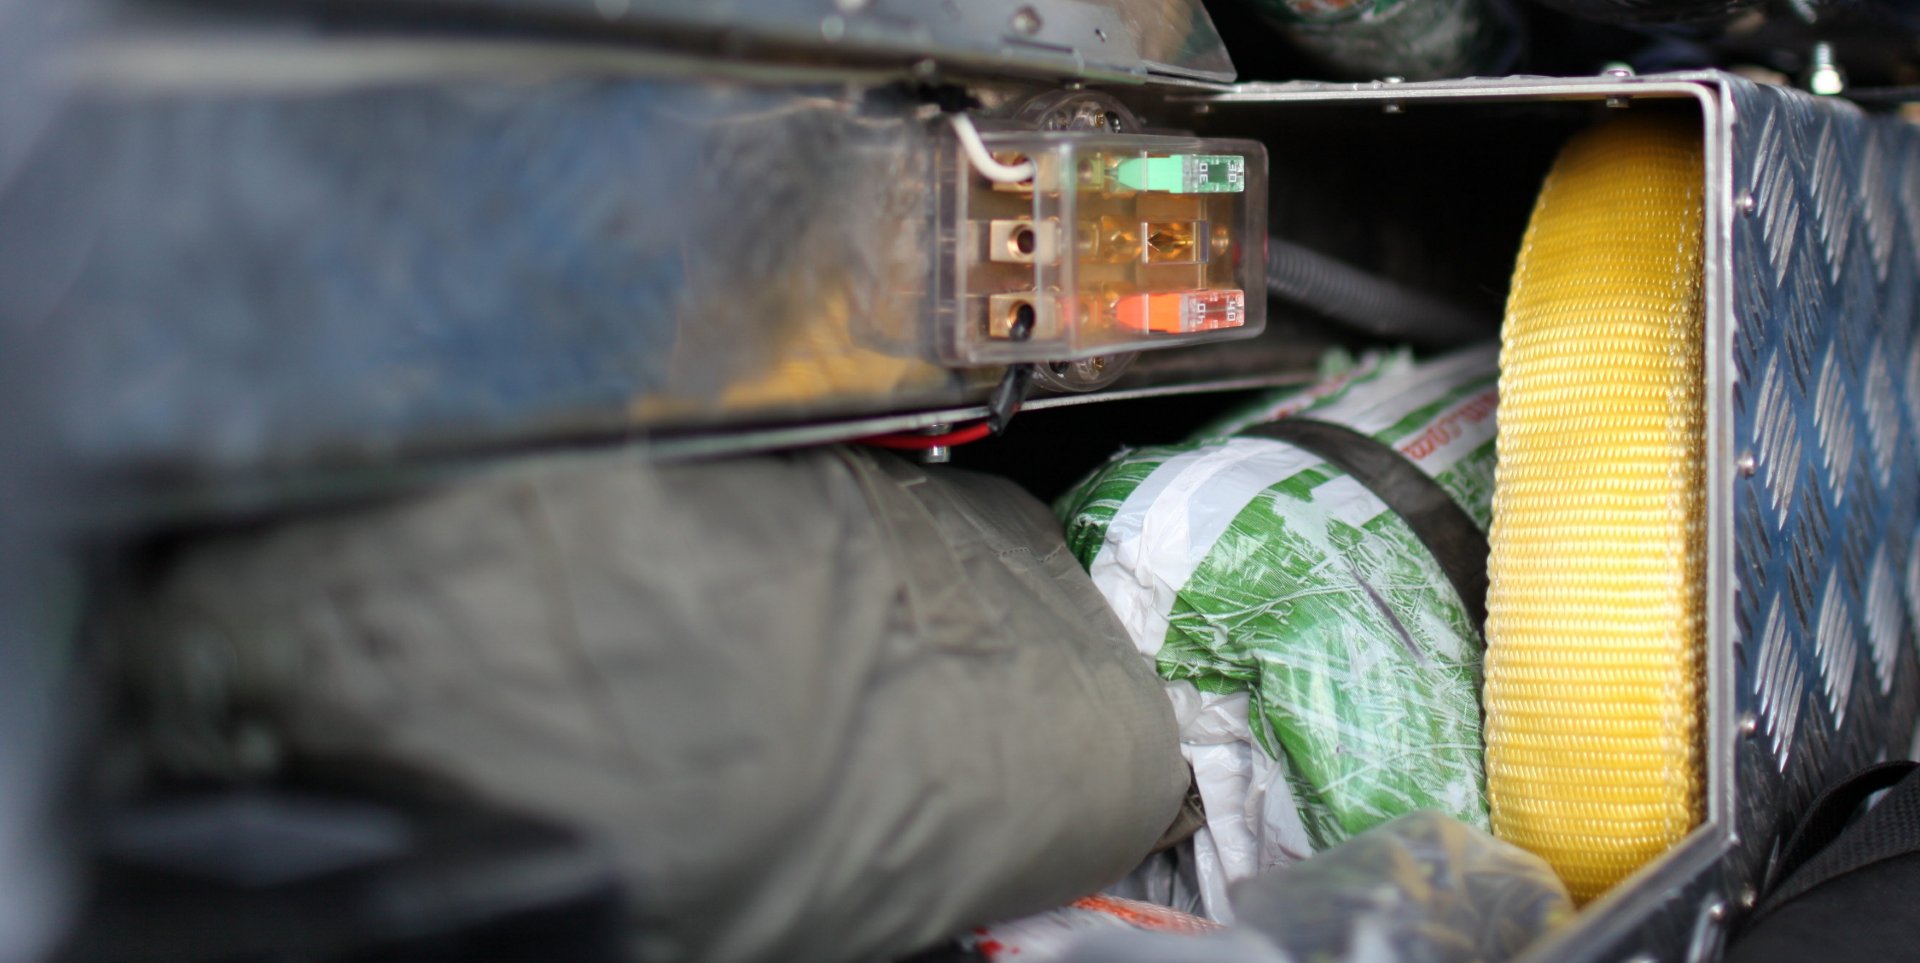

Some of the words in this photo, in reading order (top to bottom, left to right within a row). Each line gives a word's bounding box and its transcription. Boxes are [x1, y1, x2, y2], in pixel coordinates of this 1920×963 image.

[1199, 162, 1208, 183] 30
[1228, 161, 1237, 182] 30
[1197, 303, 1206, 324] 40
[1226, 300, 1236, 321] 40
